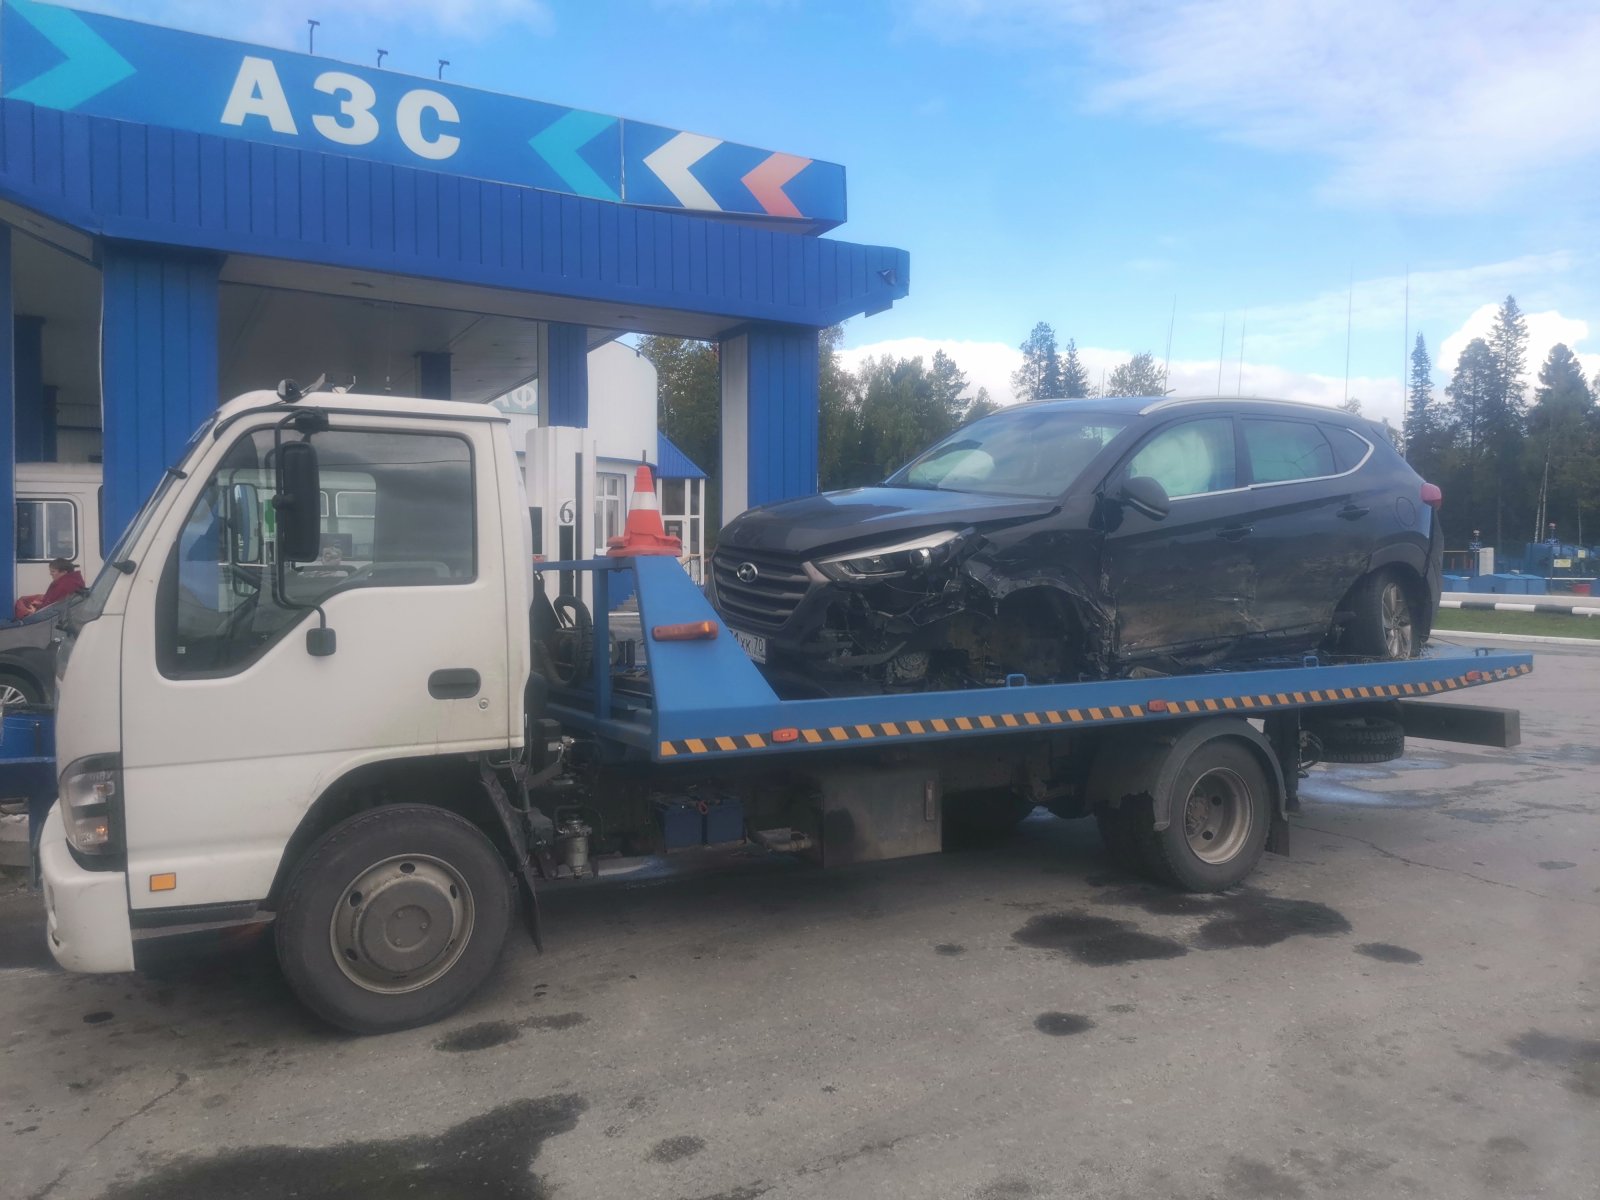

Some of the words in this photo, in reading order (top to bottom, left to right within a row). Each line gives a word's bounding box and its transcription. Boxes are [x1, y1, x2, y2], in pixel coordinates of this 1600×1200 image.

[220, 55, 461, 160] АЗС
[560, 500, 574, 524] 6
[753, 636, 764, 652] 70
